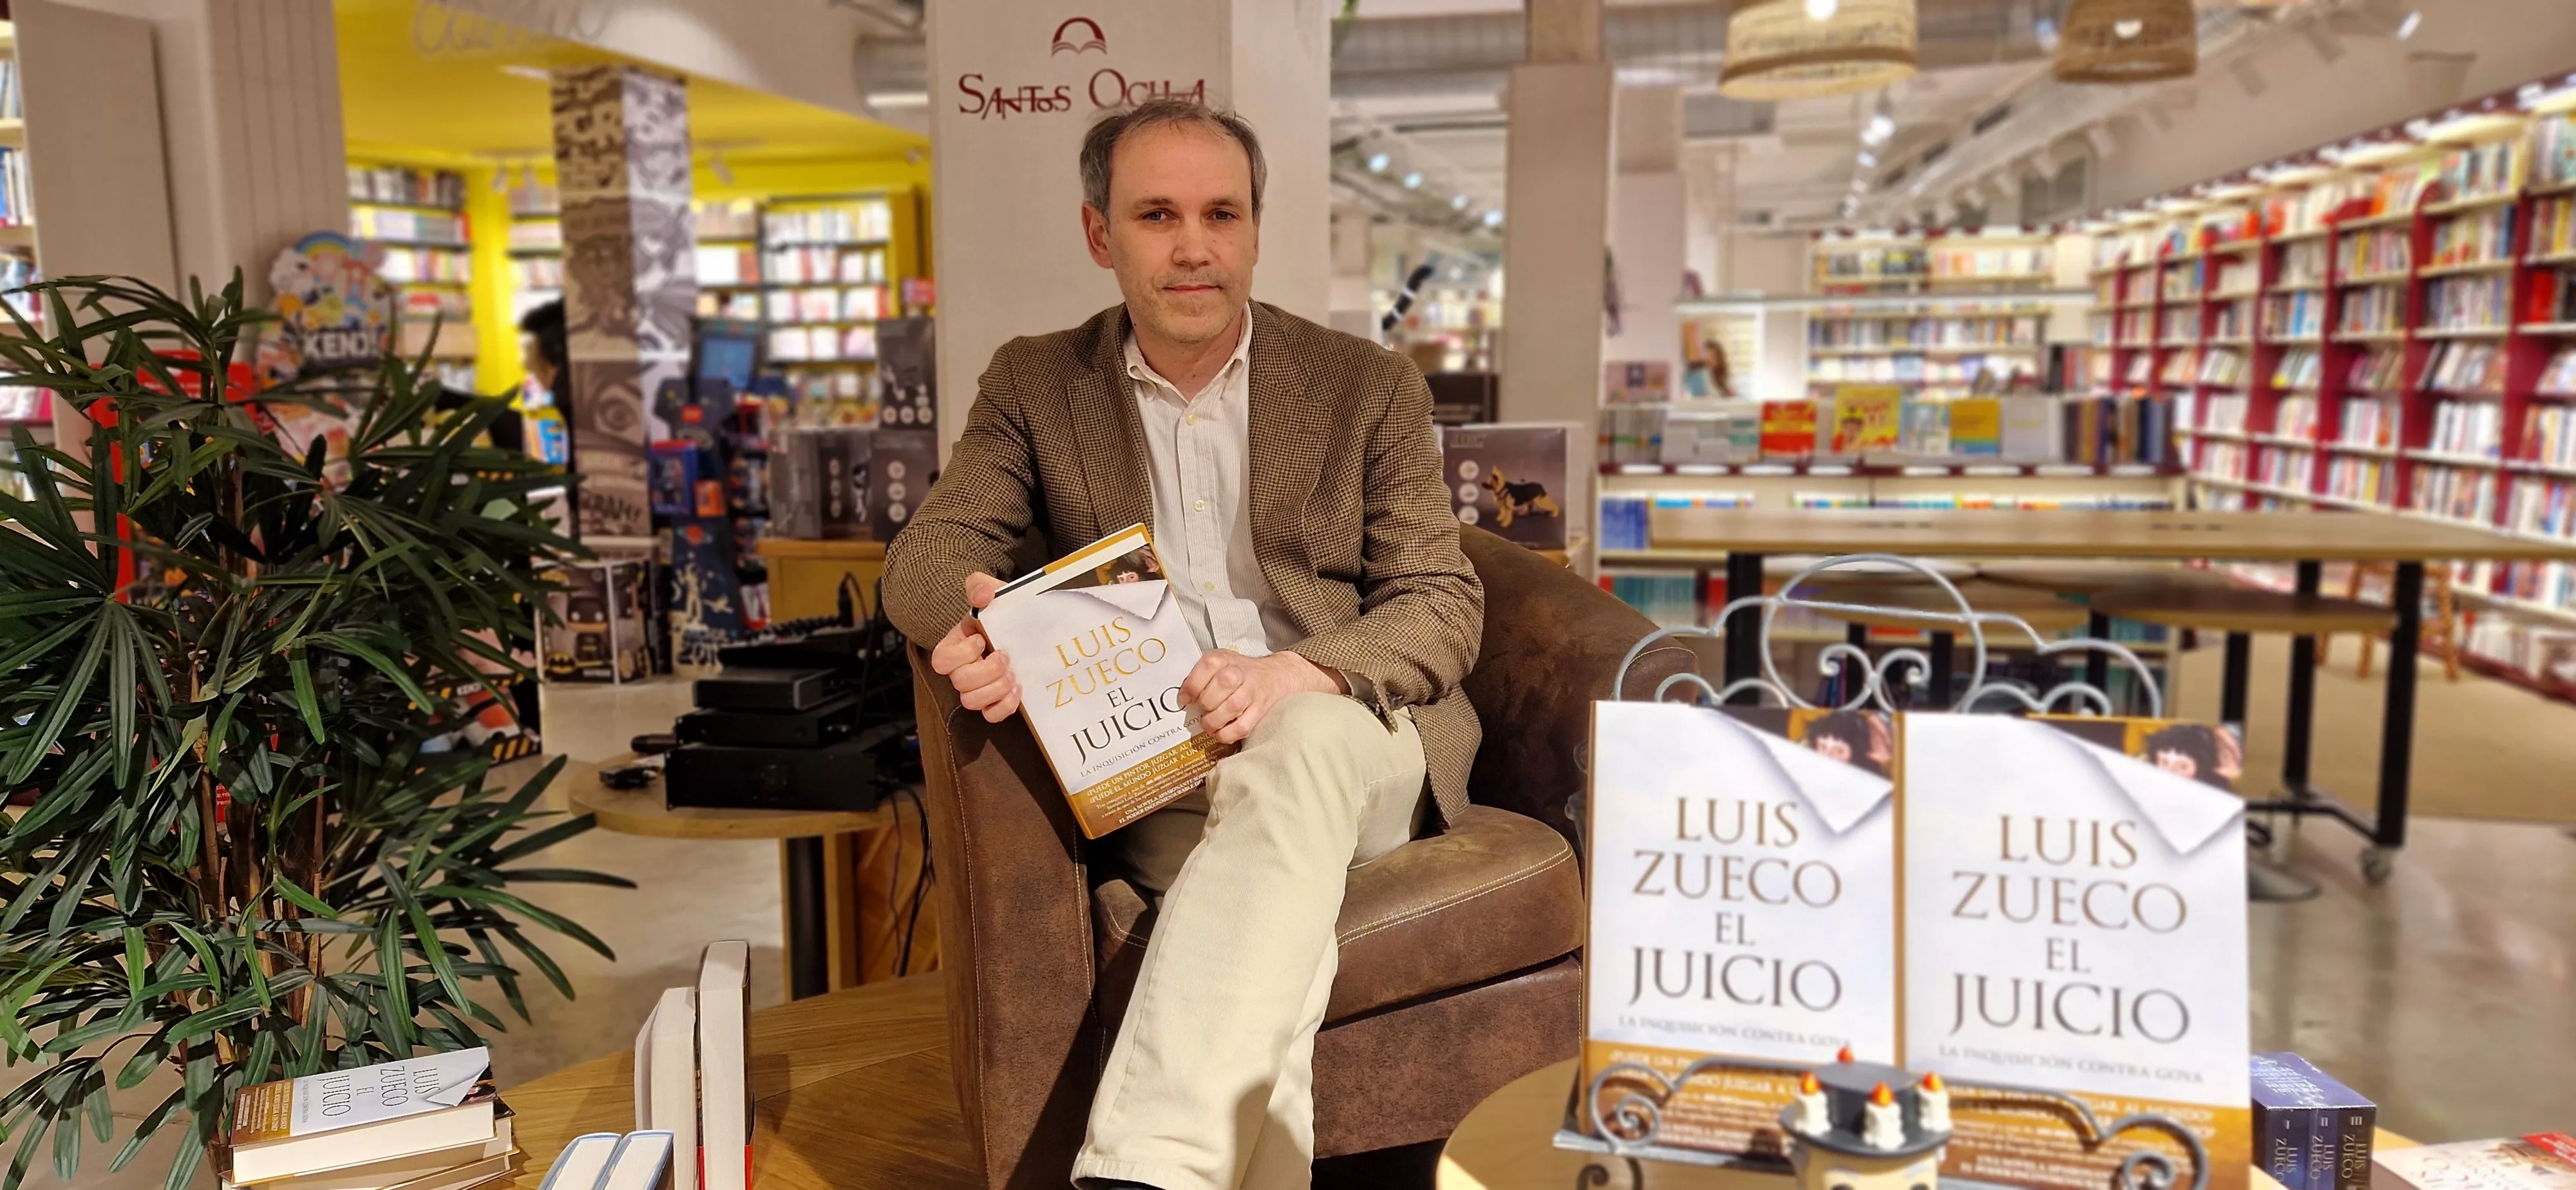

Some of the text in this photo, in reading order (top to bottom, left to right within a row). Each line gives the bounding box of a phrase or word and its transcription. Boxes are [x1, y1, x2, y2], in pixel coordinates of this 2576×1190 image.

[1088, 68, 1206, 109] OCHA
[1055, 616, 1132, 668] LUIS
[1046, 638, 1166, 708] ZUECO
[1106, 686, 1134, 708] EL
[1069, 686, 1186, 766] JUICIO
[1079, 715, 1201, 777] LA INQUISICIÓN CONTRA GOY
[1086, 732, 1212, 797] ¿PUEDE UN PINTOR JUZGAR AL MUND
[1088, 788, 1114, 804] ¿PUEDE
[1113, 783, 1123, 792] EL
[1122, 769, 1152, 788] MUNDO
[1151, 756, 1179, 775] JUZGAR
[1186, 746, 1198, 757] UN
[1118, 816, 1127, 824] EL
[1125, 808, 1144, 820] PODER
[1124, 806, 1137, 815] UNA
[1135, 795, 1159, 809] NOVELA
[1157, 777, 1194, 799] APASIONANTE
[1676, 797, 1799, 849] LUIS
[1999, 814, 2138, 870] LUIS
[1632, 849, 1842, 909] ZUECO
[1951, 869, 2188, 934] ZUECO
[1714, 911, 1757, 946] EL
[2045, 936, 2092, 974] EL
[1627, 945, 1842, 1013] JUICIO
[1949, 972, 2191, 1044] JUICIO
[1618, 1015, 1637, 1028] LA
[1741, 1026, 1807, 1045] CONTRA
[379, 1065, 410, 1107] ZUECO
[412, 1068, 442, 1095] LUIS
[1938, 1043, 1960, 1058] LA
[2077, 1058, 2152, 1080] CONTRA
[2155, 1066, 2205, 1086] GOYA
[315, 1074, 352, 1117] JUICIO
[355, 1086, 375, 1097] EL
[2320, 1117, 2329, 1128] II
[2350, 1116, 2363, 1126] III
[2274, 1137, 2287, 1183] ZUECO
[2286, 1147, 2298, 1174] LUIS
[2310, 1135, 2324, 1180] ZUECO
[2322, 1144, 2334, 1171] LUIS
[2341, 1133, 2356, 1179] ZUECO
[2354, 1142, 2367, 1170] LUIS
